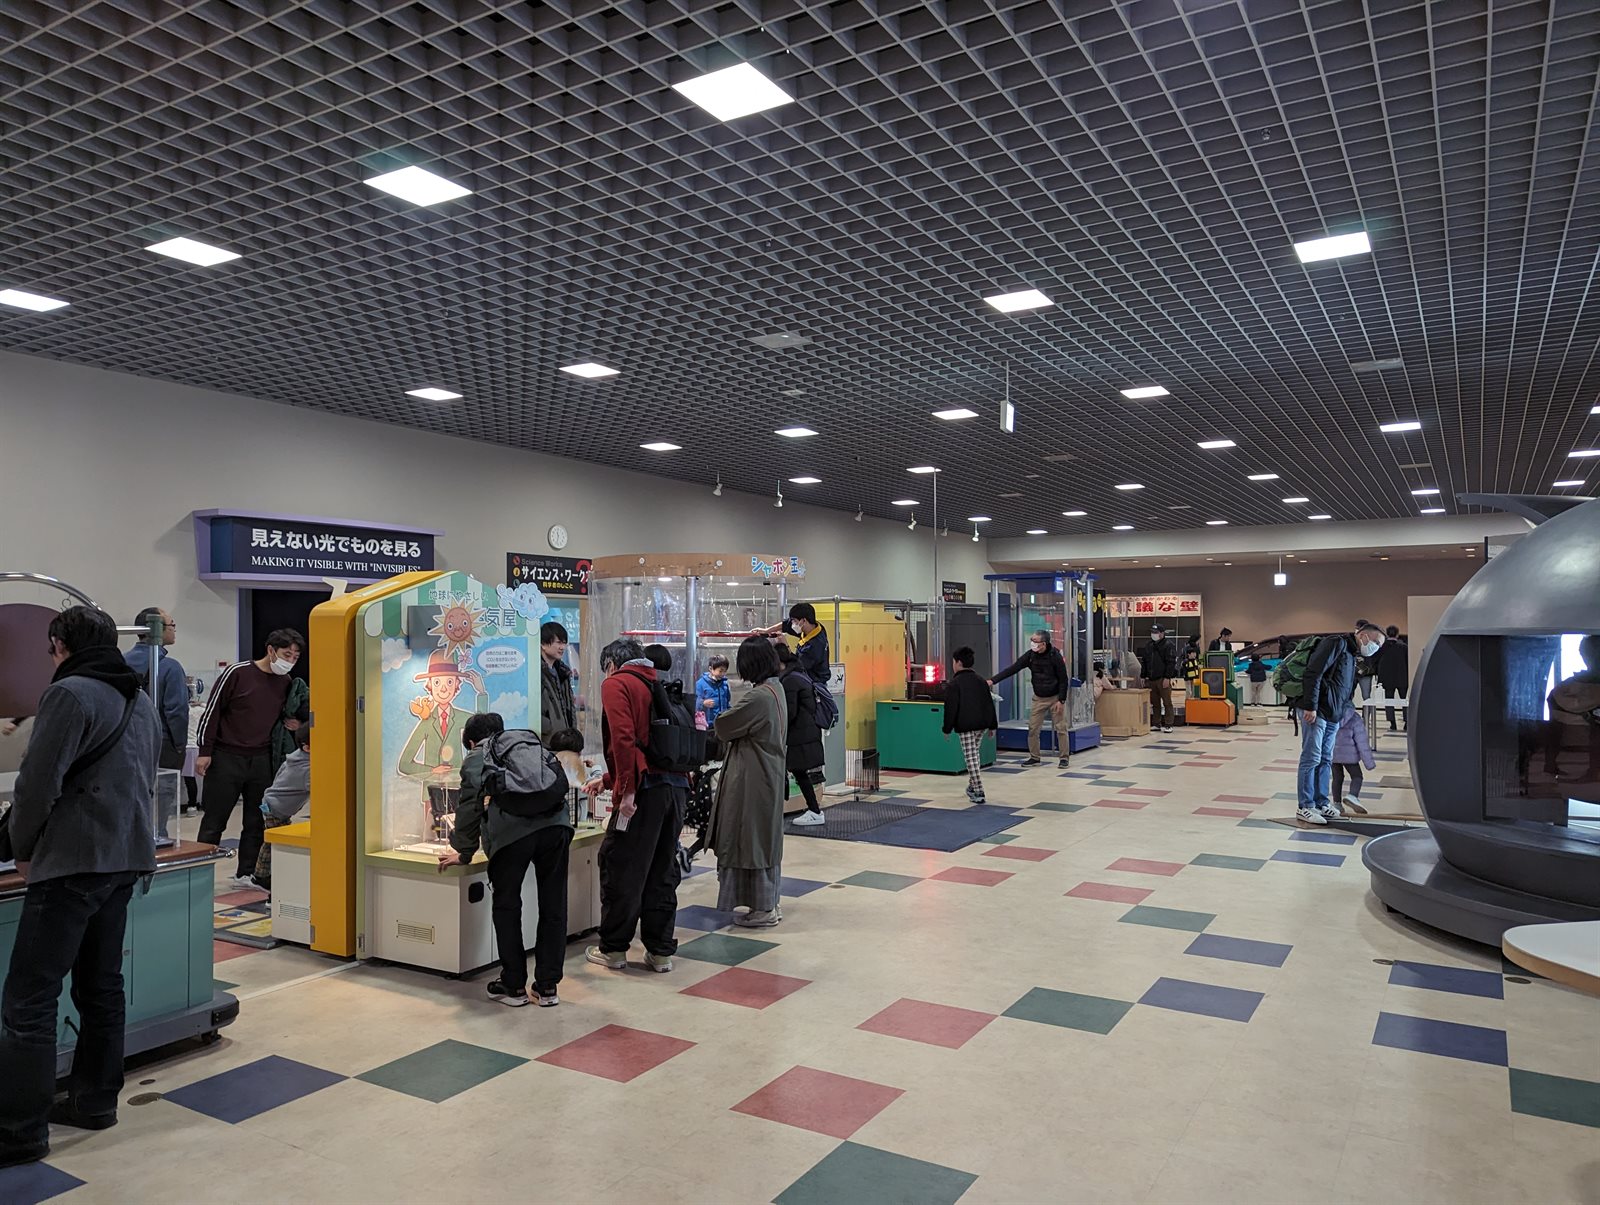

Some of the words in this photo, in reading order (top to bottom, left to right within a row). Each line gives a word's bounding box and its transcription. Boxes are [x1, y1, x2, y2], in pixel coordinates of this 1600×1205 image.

[251, 528, 421, 558] 見えない光でものを見る
[251, 556, 294, 567] MAKING
[296, 558, 305, 568] IT
[307, 559, 343, 570] VISIBLE
[345, 561, 368, 571] WITH
[521, 559, 545, 567] Science
[542, 581, 574, 589] 科学者のしごと
